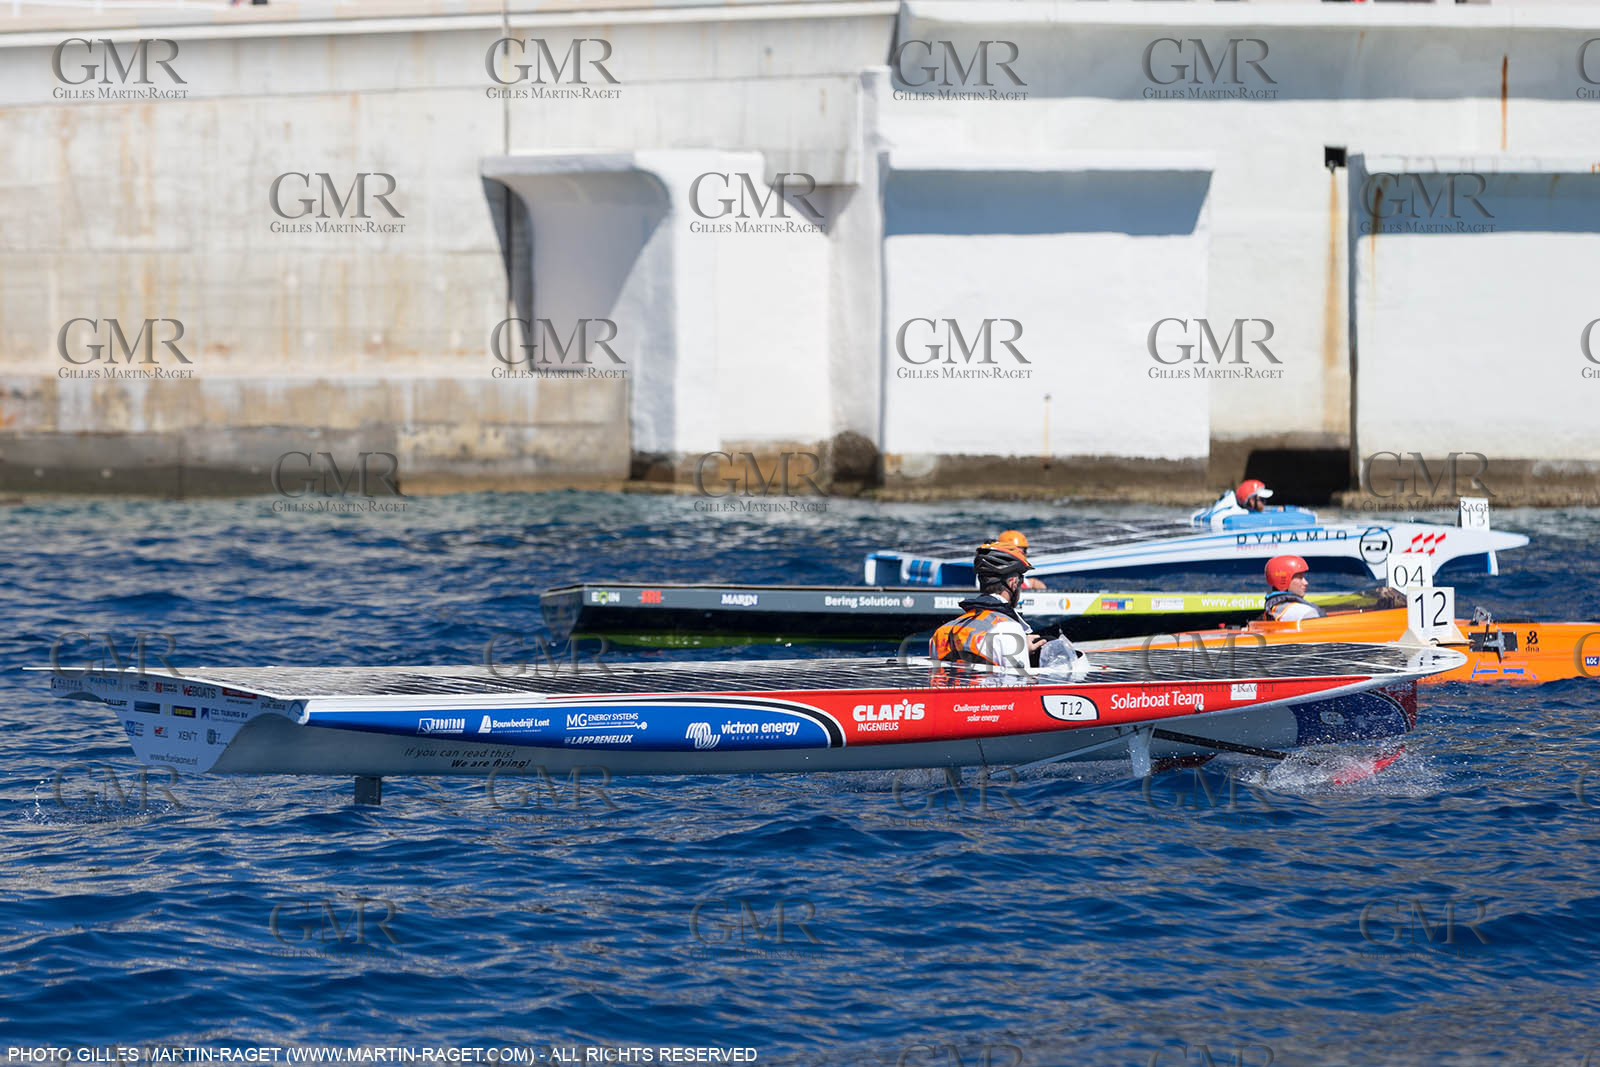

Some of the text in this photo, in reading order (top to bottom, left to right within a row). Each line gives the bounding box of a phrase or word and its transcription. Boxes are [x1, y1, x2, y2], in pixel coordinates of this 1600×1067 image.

[1393, 564, 1425, 587] 04
[824, 596, 900, 609] Bering Solution
[1415, 591, 1448, 629] 12
[1110, 690, 1204, 710] Solarboat Team
[953, 703, 1015, 713] Challenge the power of
[1060, 701, 1082, 716] T12
[566, 713, 588, 727] MG
[588, 712, 639, 722] ENERGY SYSTEMS
[981, 715, 1000, 723] energy
[721, 720, 800, 736] victron energy
[857, 722, 899, 732] INGENIEUS
[571, 734, 634, 745] LAPP BENELUX
[404, 747, 516, 760] If you can read this!
[451, 758, 532, 770] We are flying!
